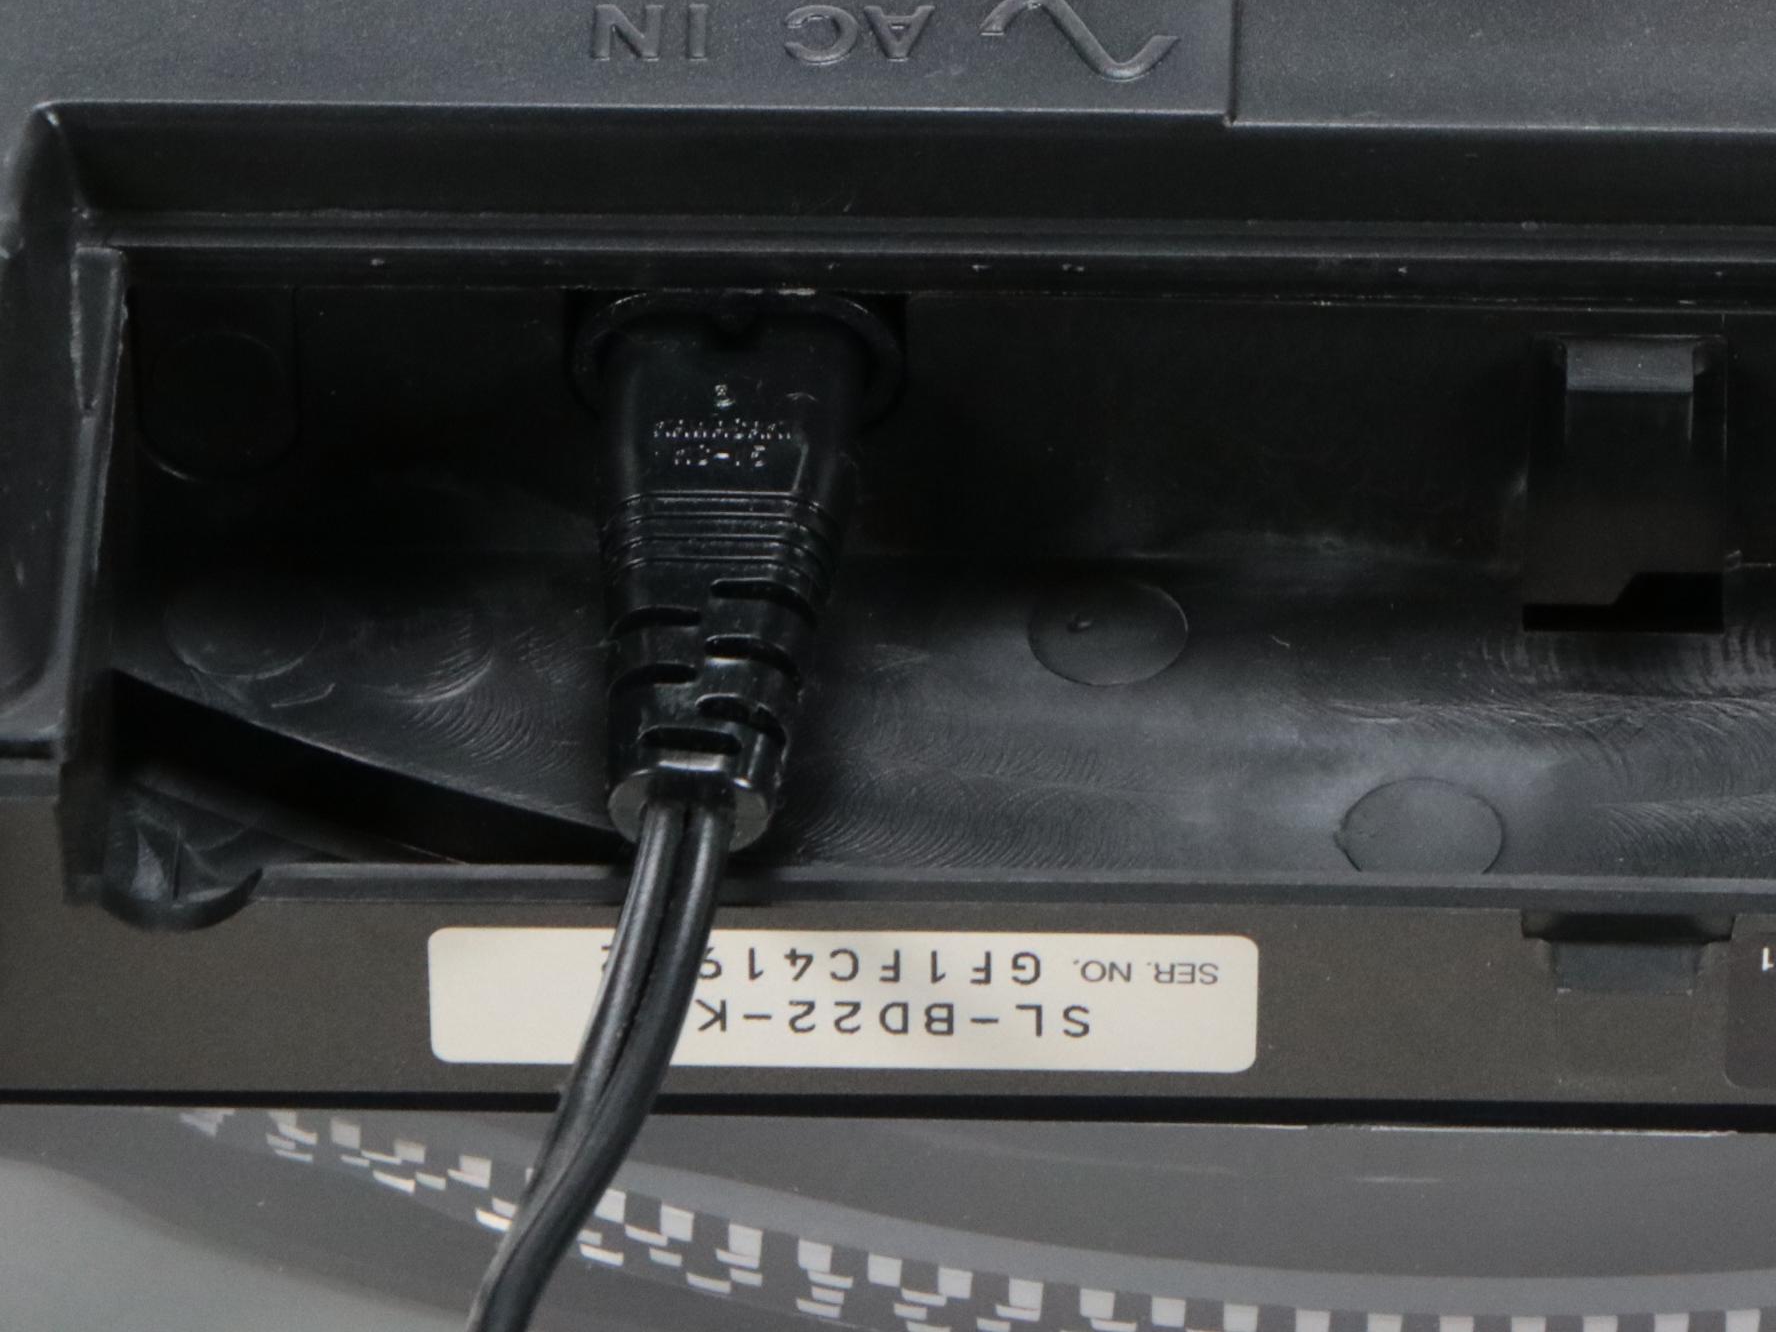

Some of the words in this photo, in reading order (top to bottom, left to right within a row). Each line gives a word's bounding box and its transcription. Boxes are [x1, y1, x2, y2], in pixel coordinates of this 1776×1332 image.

[591, 2, 710, 63] IN
[784, 3, 934, 66] AC
[1073, 959, 1132, 984] NO.
[1147, 961, 1219, 985] SER.
